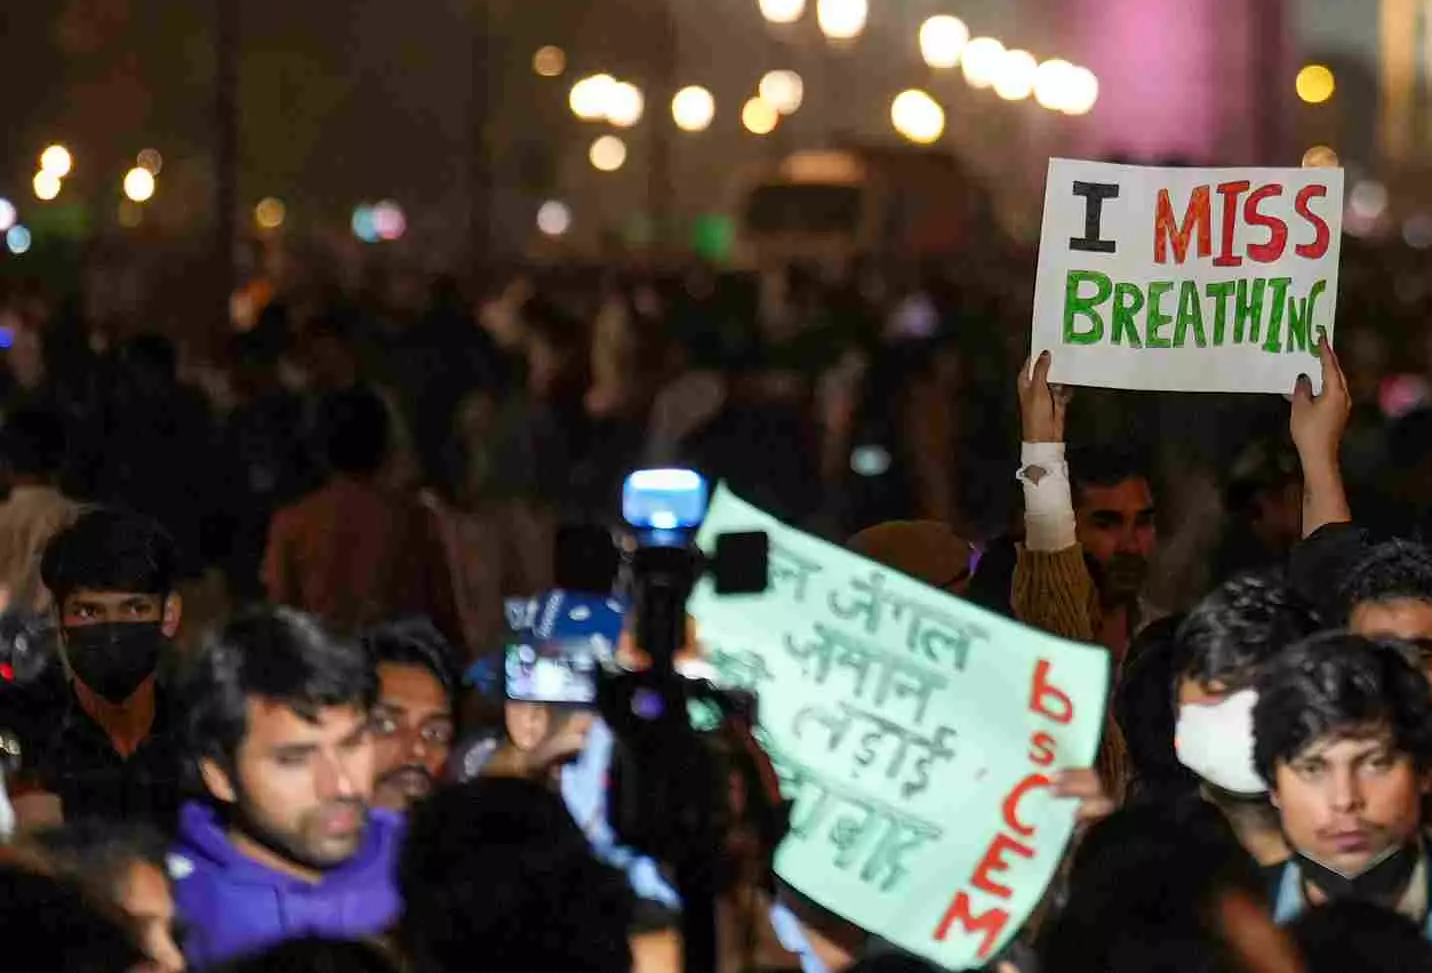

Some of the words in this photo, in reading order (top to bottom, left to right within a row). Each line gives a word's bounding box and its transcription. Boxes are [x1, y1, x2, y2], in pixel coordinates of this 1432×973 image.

[1069, 180, 1120, 253] I
[1153, 179, 1330, 267] MISS
[1062, 269, 1327, 357] BREATHING
